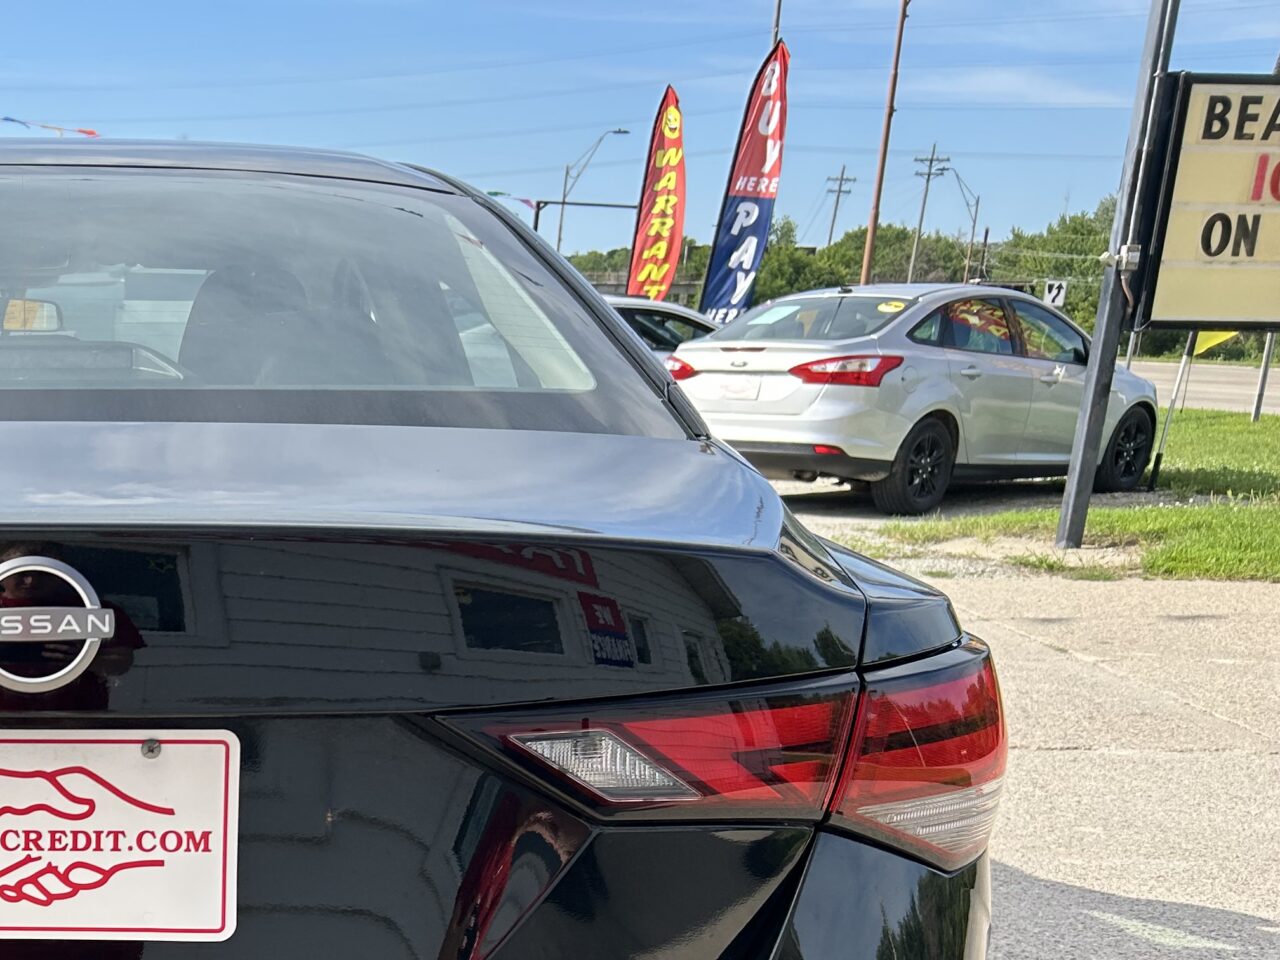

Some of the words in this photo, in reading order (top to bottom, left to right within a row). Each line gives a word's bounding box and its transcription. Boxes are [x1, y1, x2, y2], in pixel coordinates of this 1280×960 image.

[758, 61, 782, 174] BUY
[735, 176, 780, 193] HERE
[637, 147, 683, 300] WARRANT
[728, 202, 759, 305] PAY
[1201, 212, 1261, 257] ON
[704, 308, 747, 324] HER
